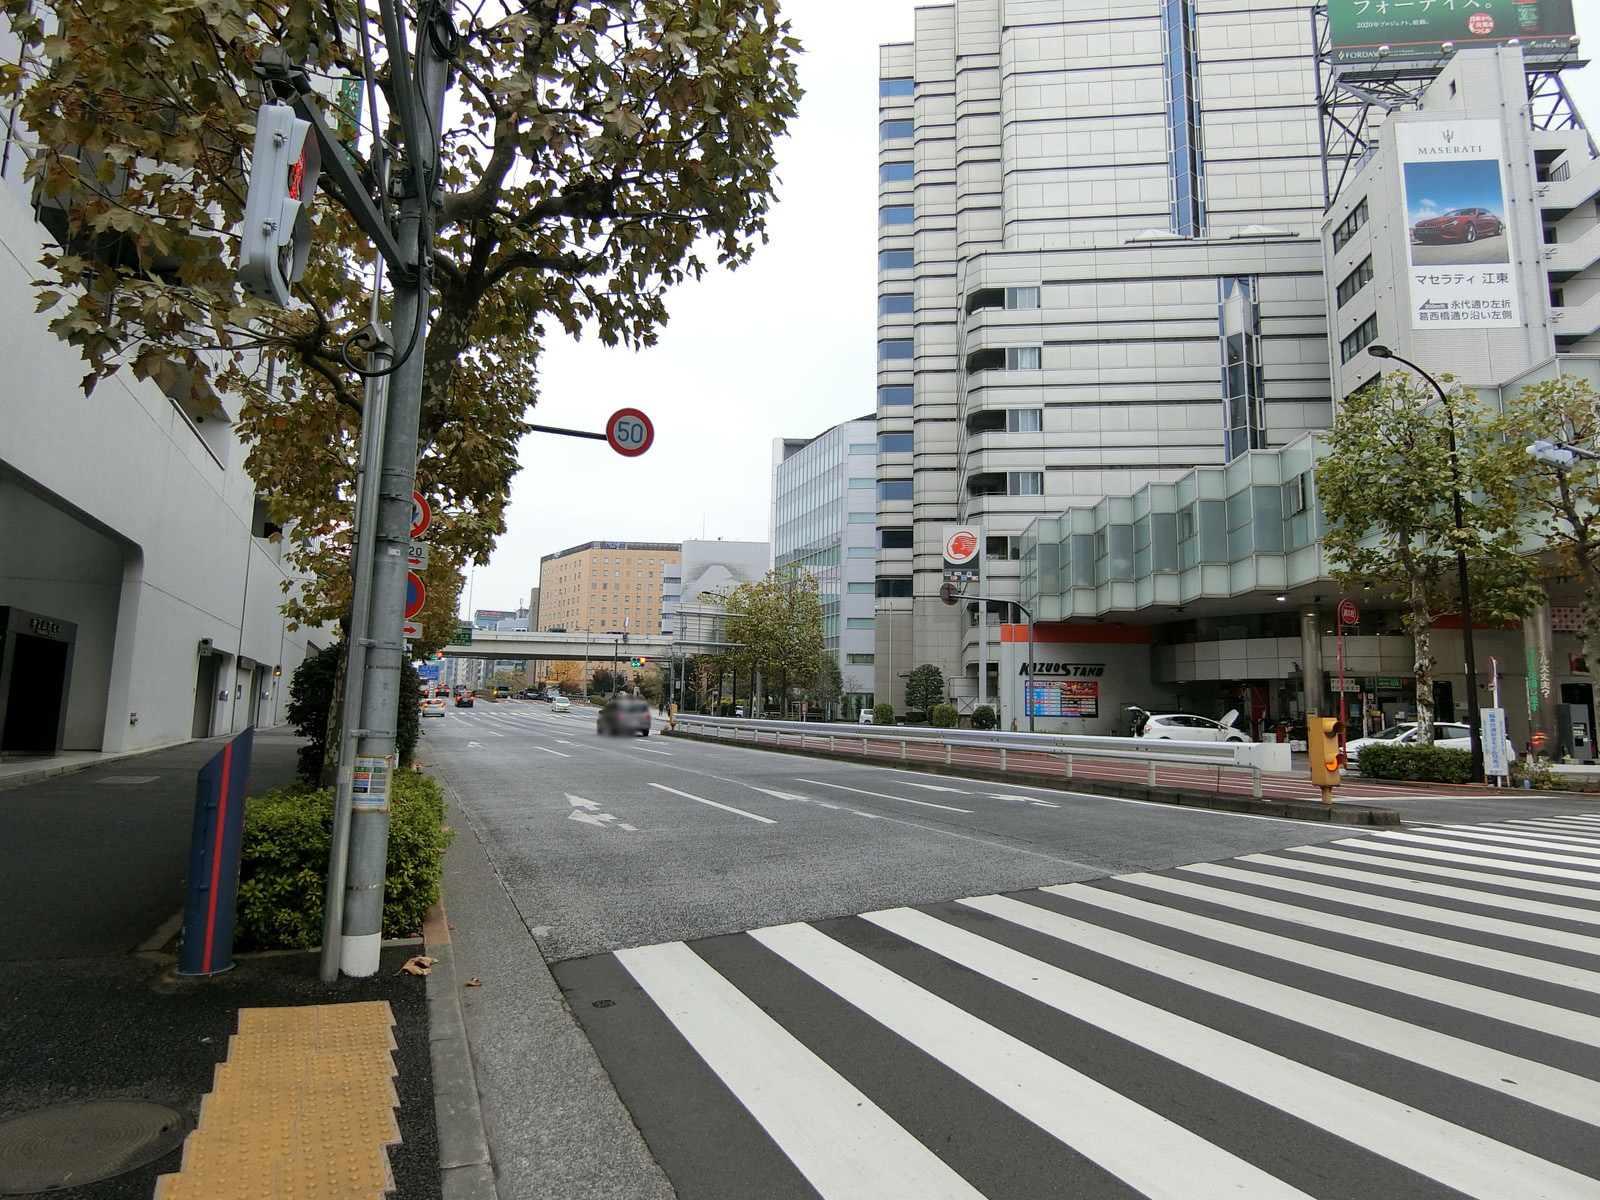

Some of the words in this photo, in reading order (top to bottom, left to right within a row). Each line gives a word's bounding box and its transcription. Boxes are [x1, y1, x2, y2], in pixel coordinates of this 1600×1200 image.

[1418, 145, 1482, 155] MASERATI
[1415, 273, 1476, 285] マセラティ
[1482, 272, 1509, 284] 江東
[1450, 299, 1511, 309] 永代通り左折
[1419, 310, 1513, 321] 葛西橋通り沿い左側
[617, 420, 643, 444] 50
